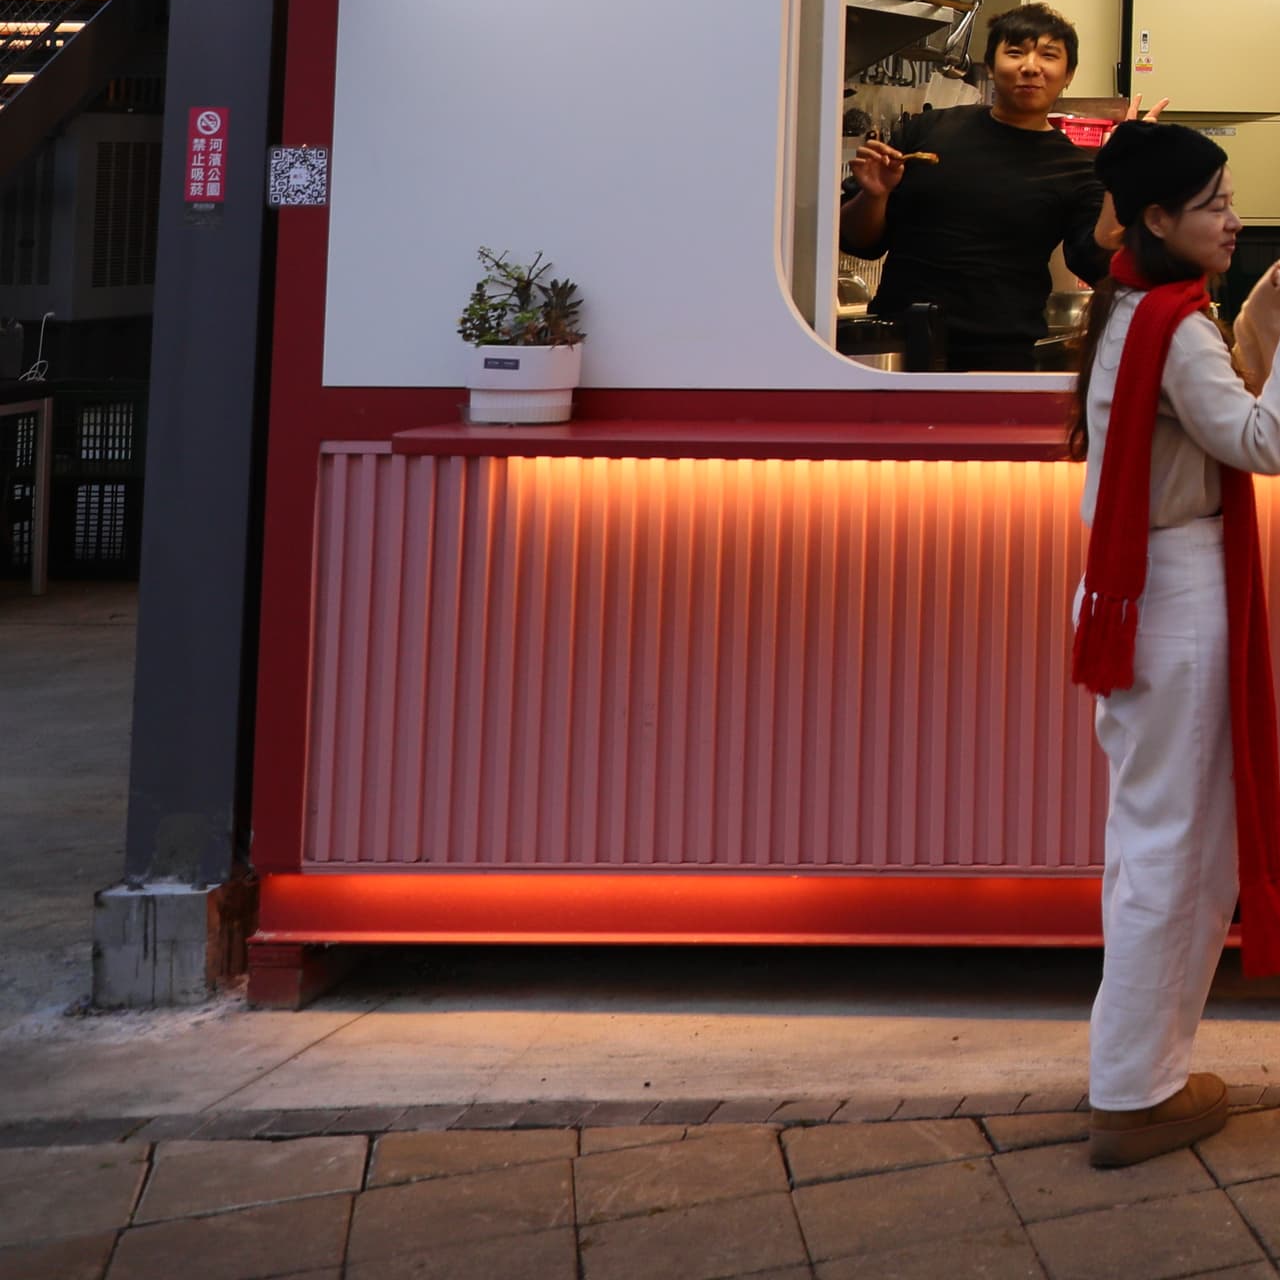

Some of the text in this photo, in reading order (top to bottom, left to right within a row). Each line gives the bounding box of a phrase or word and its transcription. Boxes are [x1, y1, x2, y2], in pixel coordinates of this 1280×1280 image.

[190, 138, 207, 197] 禁止吸菸
[206, 138, 223, 197] 河濱公園
